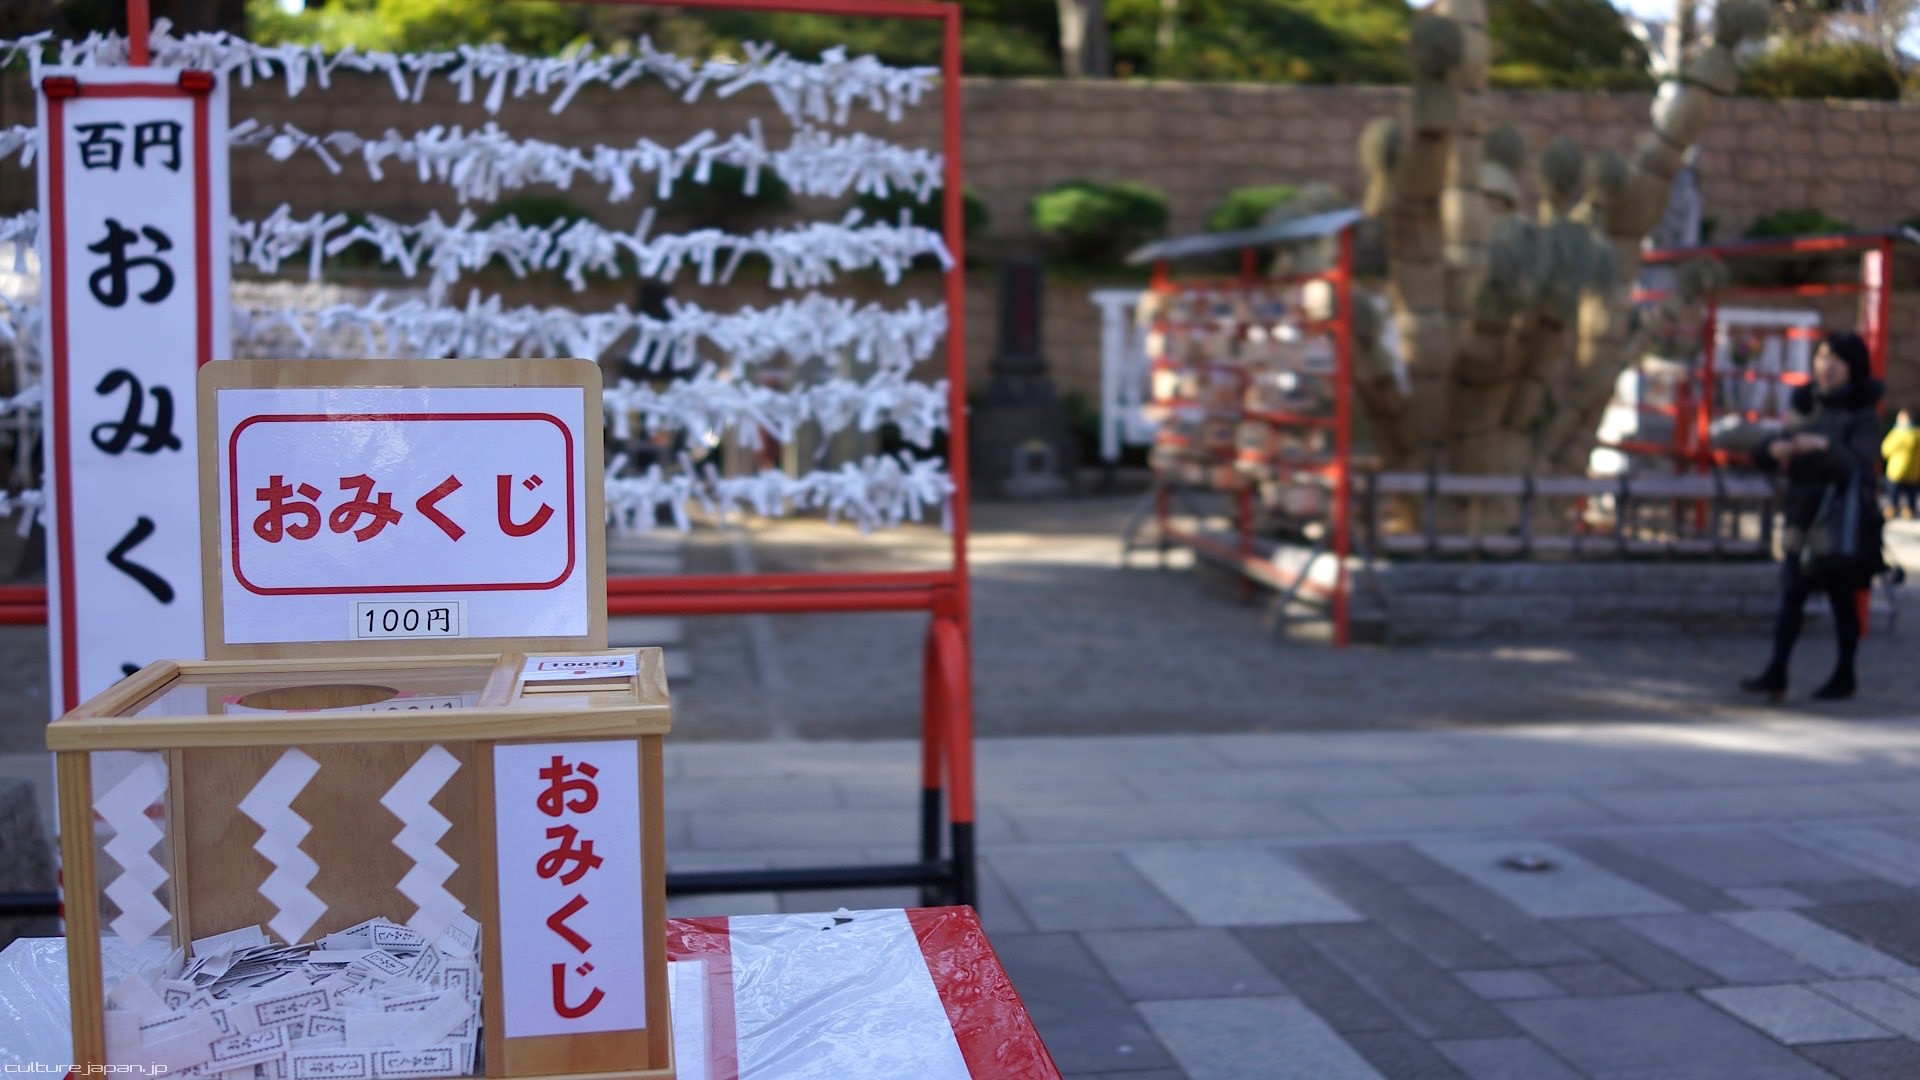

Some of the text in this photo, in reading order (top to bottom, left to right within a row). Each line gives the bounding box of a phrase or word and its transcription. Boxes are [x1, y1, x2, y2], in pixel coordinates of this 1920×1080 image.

[73, 120, 183, 173] 百円
[87, 217, 183, 687] おみく
[252, 473, 555, 543] おみくじ
[365, 607, 451, 634] 100円
[536, 755, 606, 1019] おみくじ
